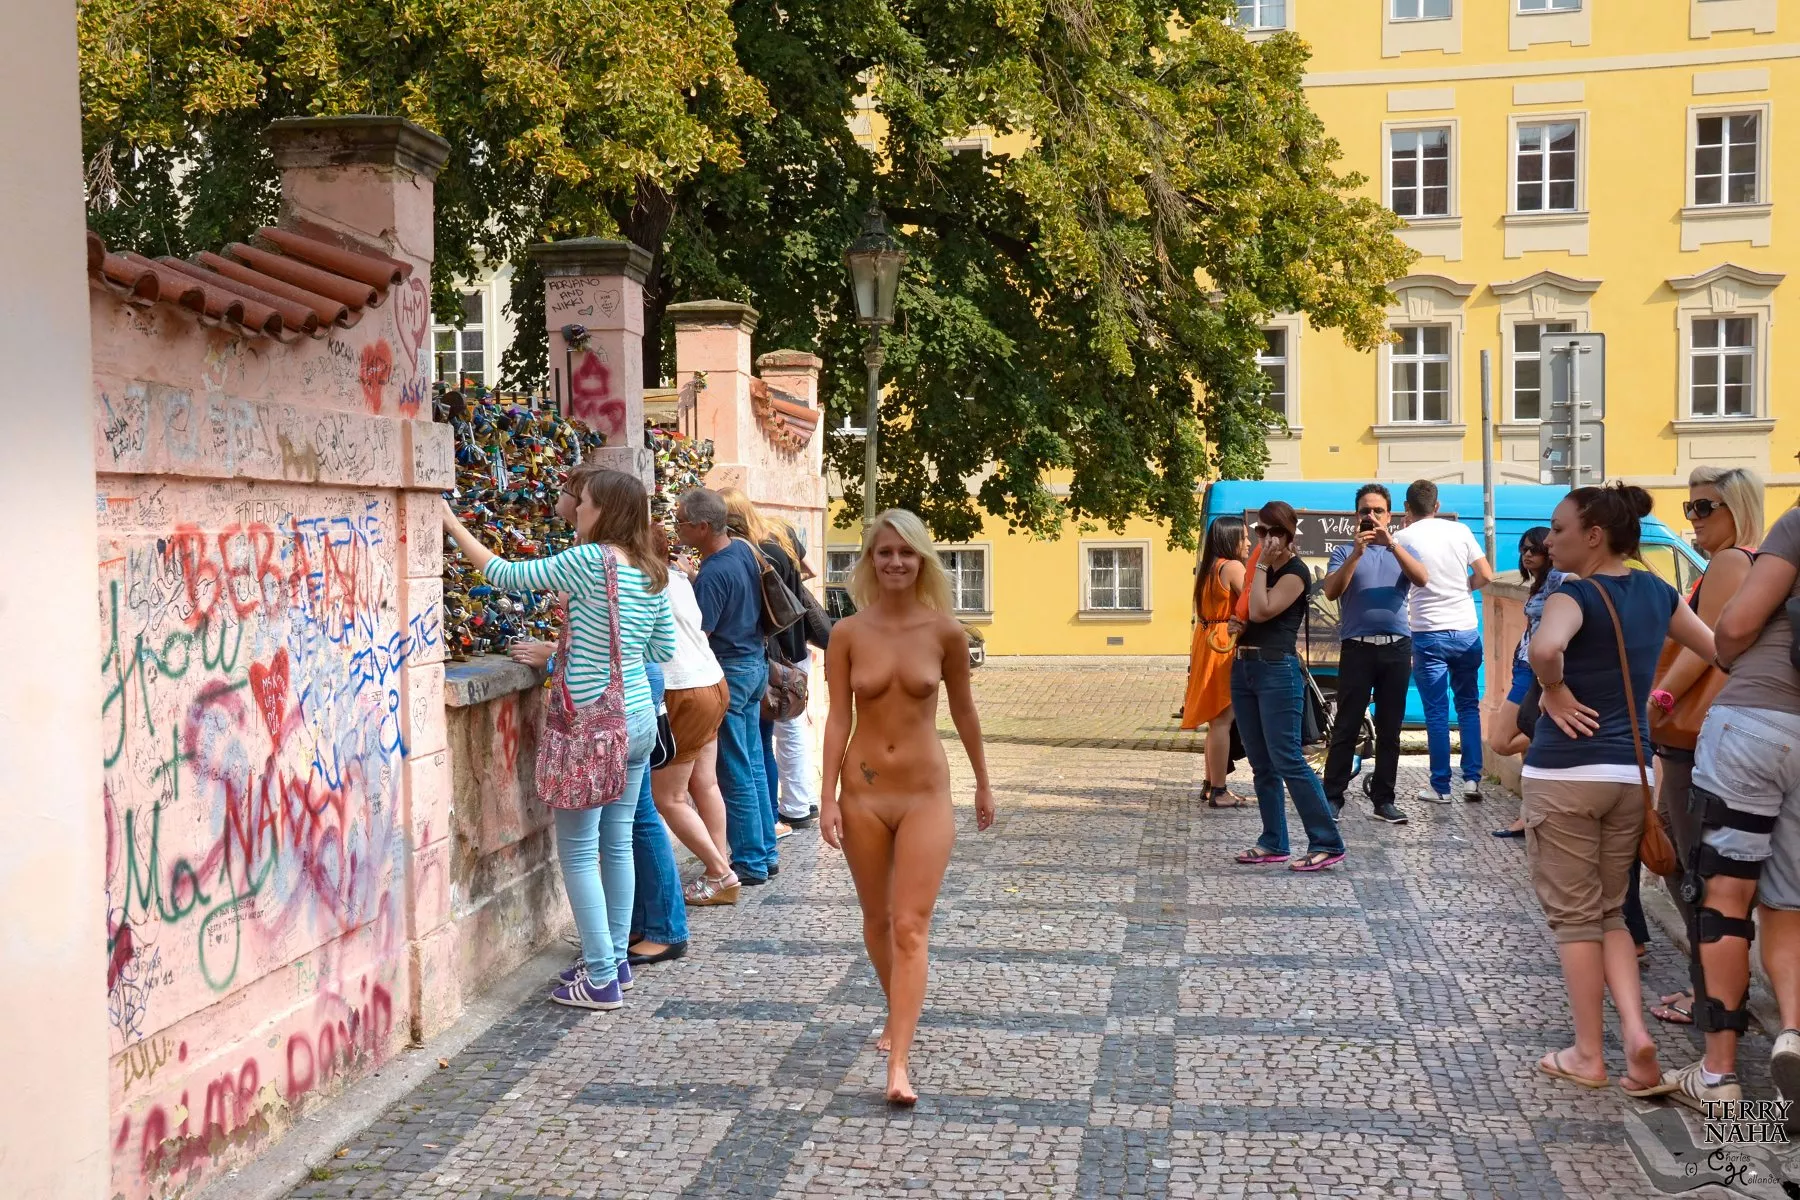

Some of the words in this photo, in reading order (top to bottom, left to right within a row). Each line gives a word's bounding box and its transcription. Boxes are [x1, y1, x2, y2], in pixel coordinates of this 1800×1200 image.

[549, 279, 600, 290] ADRIANO
[560, 289, 584, 300] AND
[551, 298, 584, 313] NIKKI
